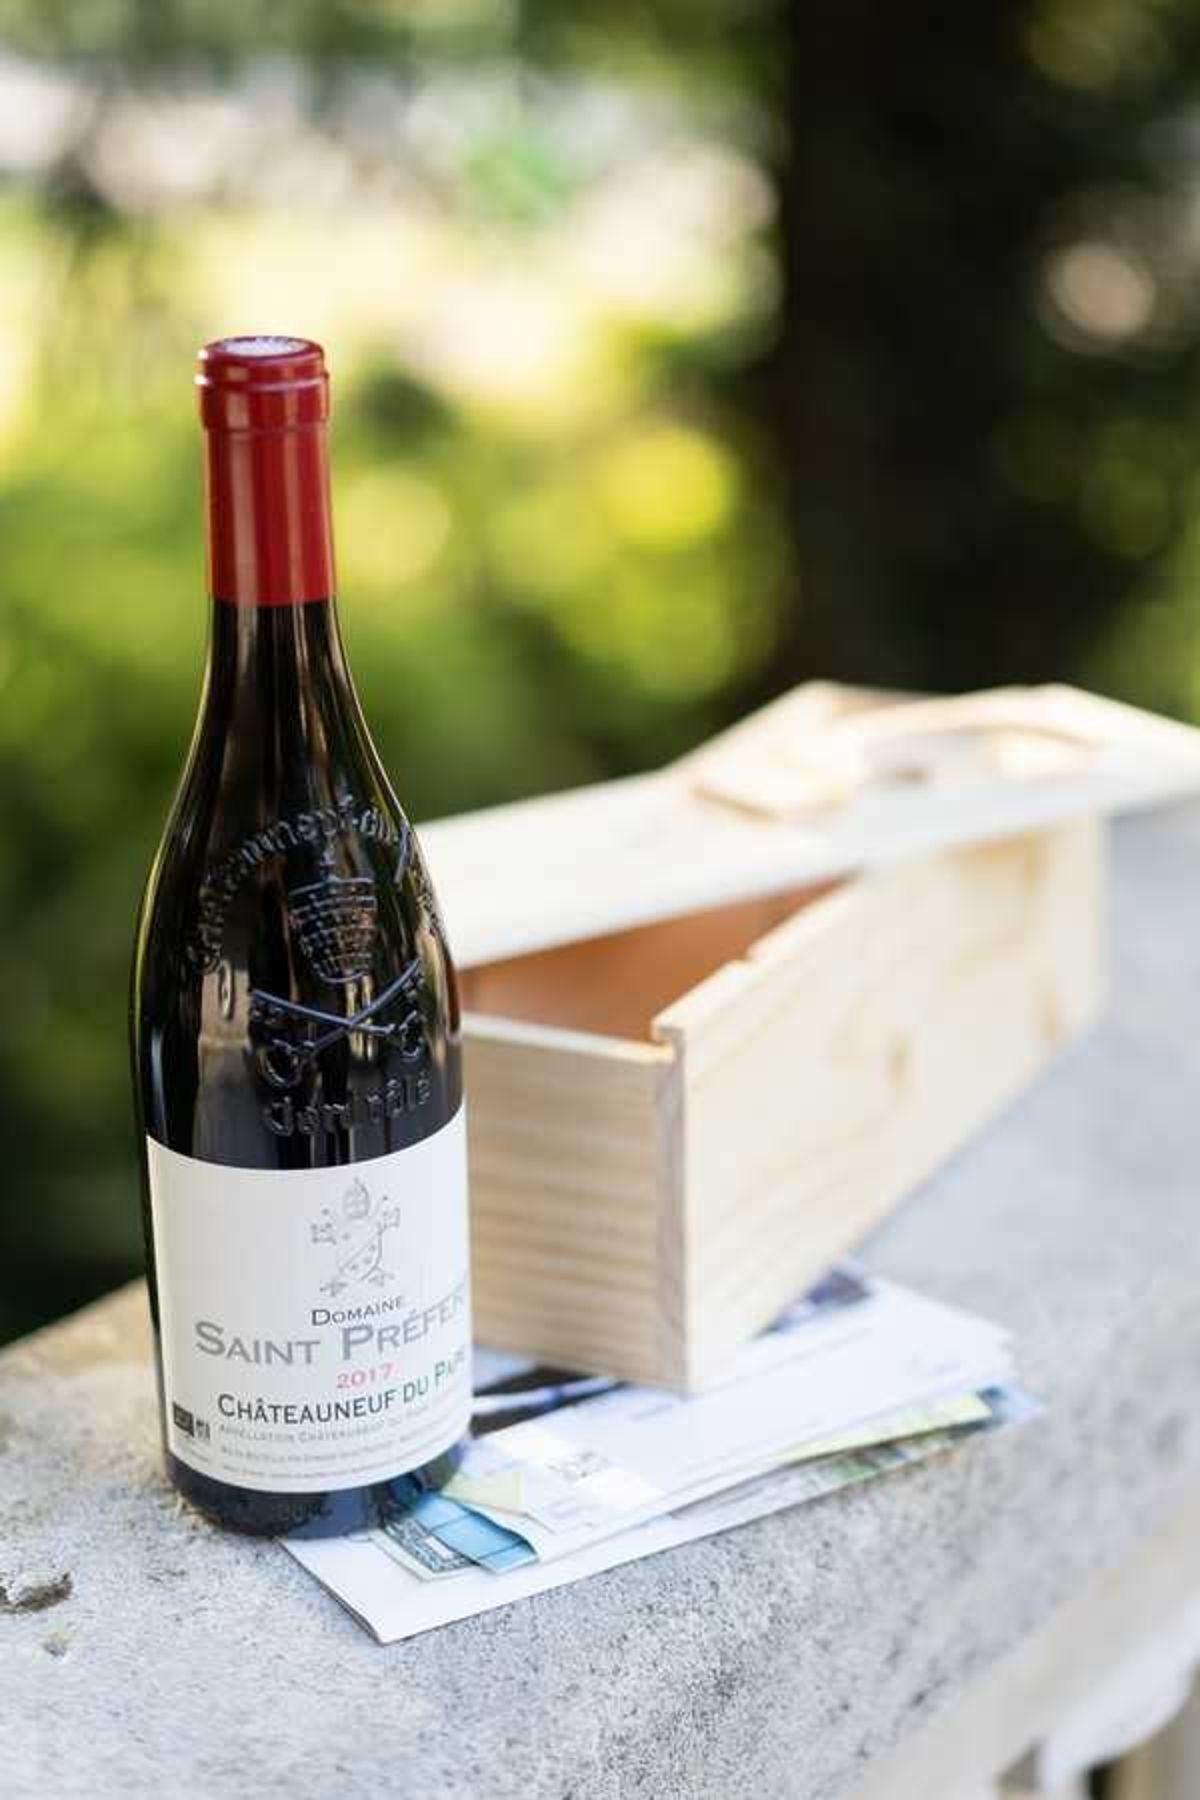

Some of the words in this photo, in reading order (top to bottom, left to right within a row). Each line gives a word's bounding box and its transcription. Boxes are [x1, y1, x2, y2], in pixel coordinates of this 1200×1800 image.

[311, 1295, 404, 1327] DOMAINE
[194, 1320, 321, 1366] SAINT
[335, 1362, 395, 1389] 2017
[217, 1392, 398, 1425] CHÂTEAUNEUF
[401, 1374, 430, 1404] DU
